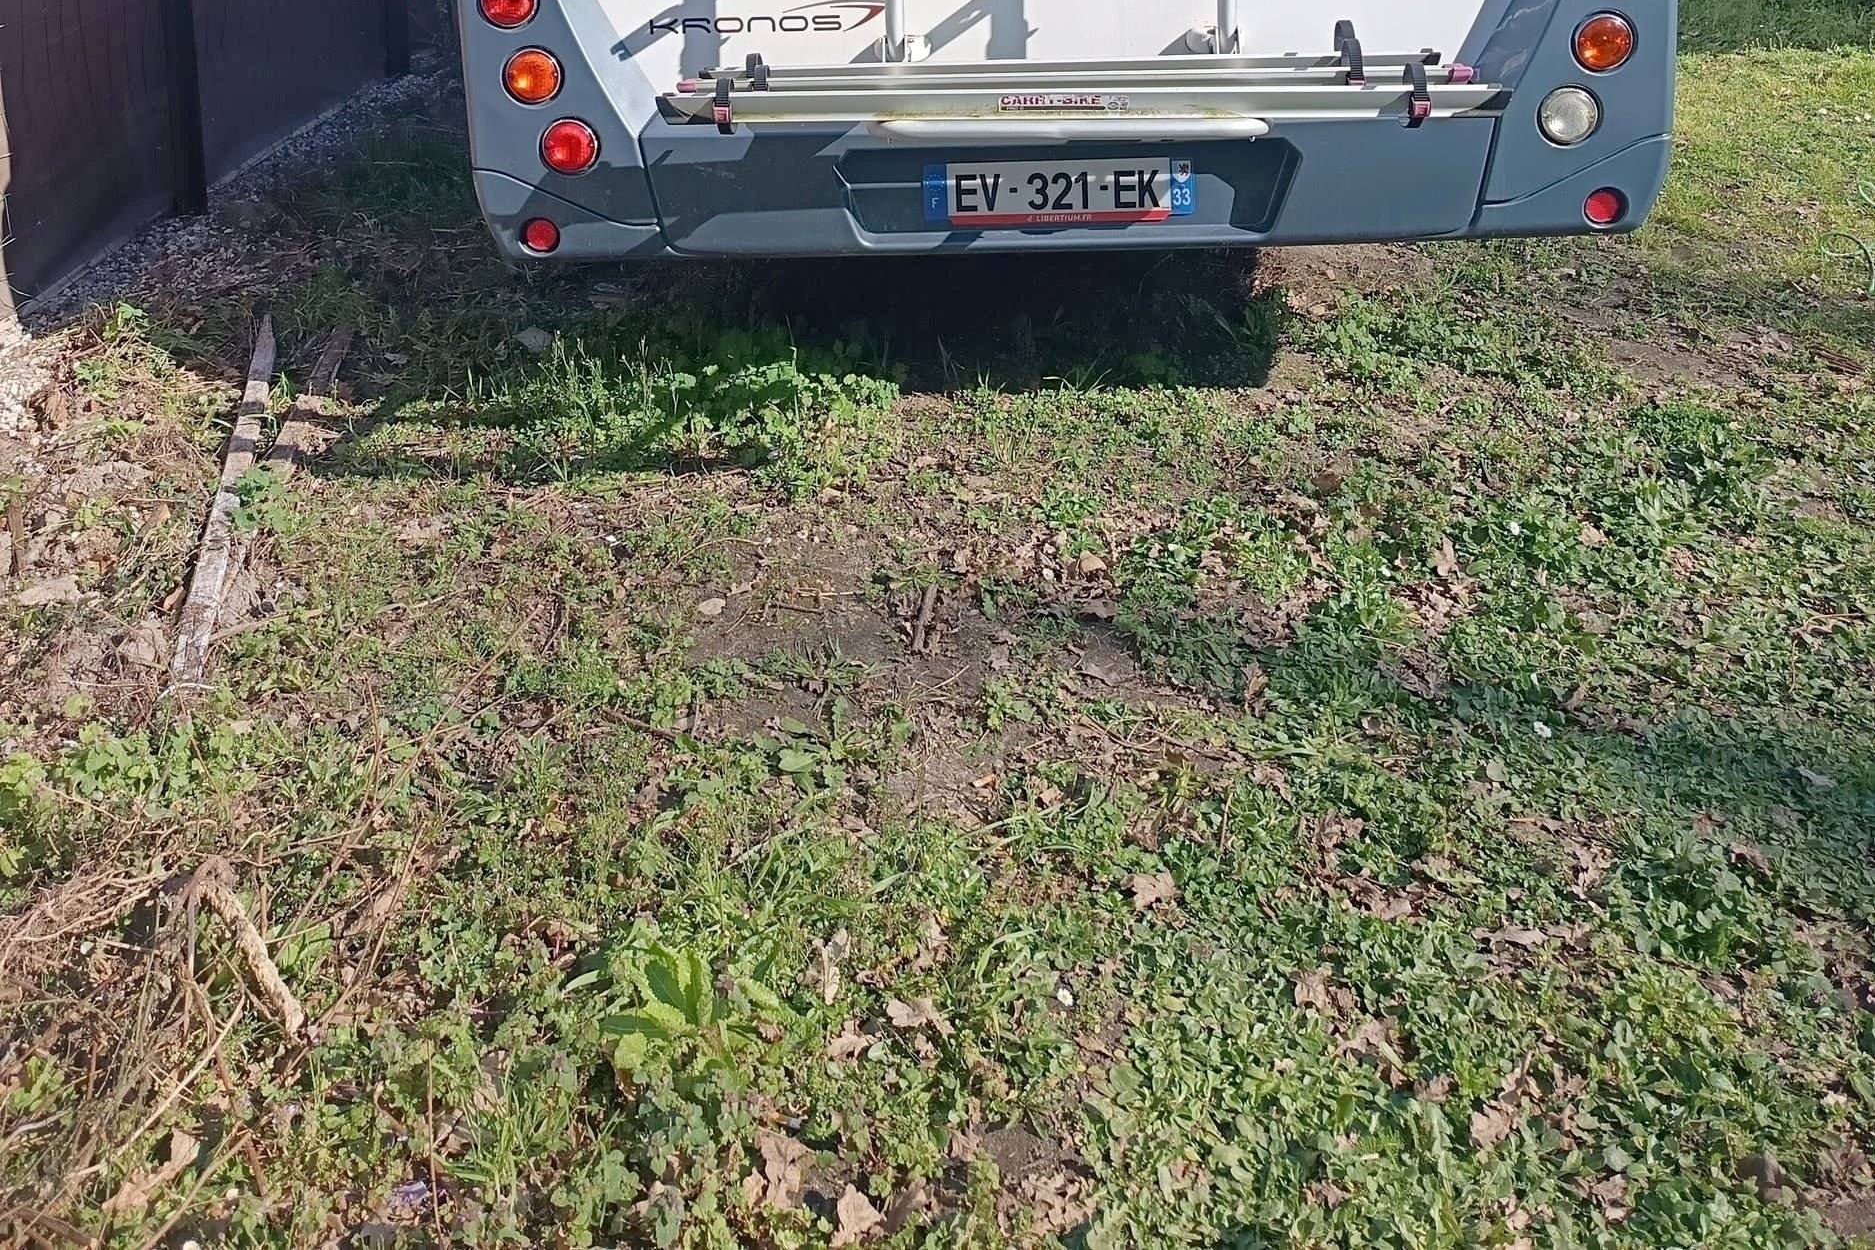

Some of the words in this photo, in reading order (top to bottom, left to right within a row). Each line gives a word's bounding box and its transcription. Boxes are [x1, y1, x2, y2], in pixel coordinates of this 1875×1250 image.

[931, 197, 939, 209] F
[1172, 188, 1191, 206] 33
[1036, 213, 1092, 222] LIBERTIUM.FR
